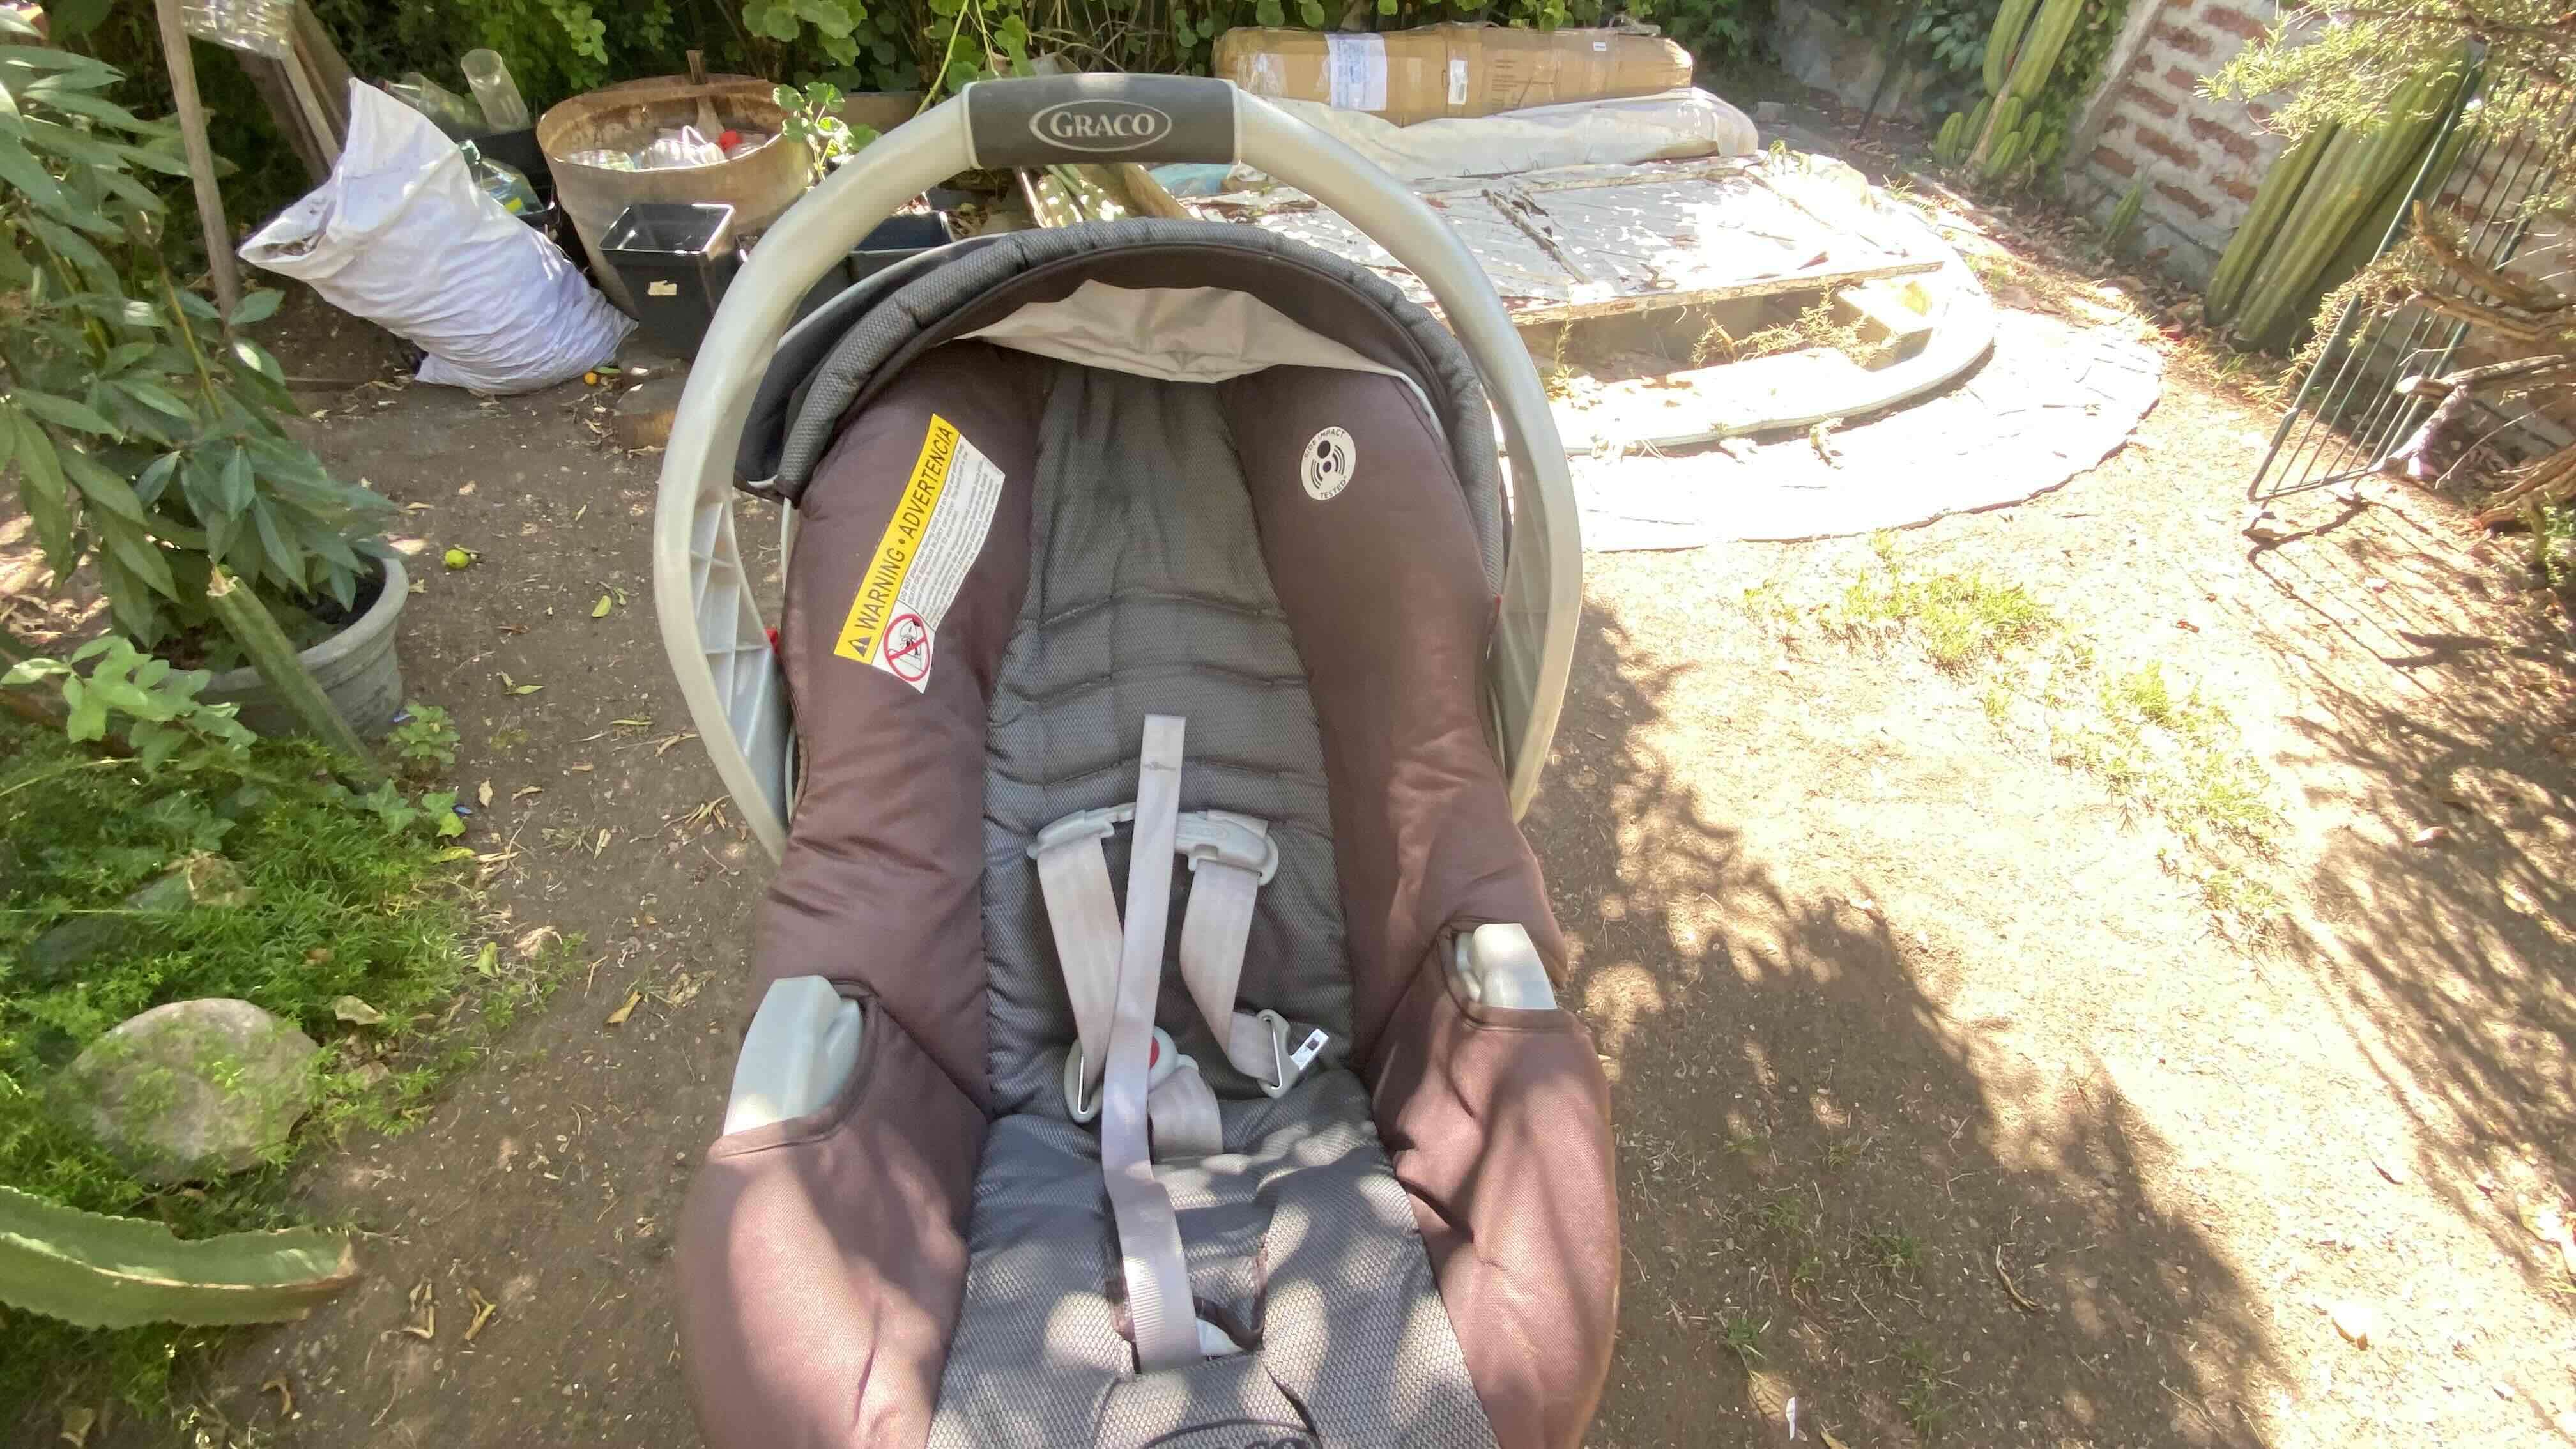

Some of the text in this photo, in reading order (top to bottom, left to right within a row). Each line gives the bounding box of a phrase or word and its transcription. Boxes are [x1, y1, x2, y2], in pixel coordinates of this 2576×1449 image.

[1050, 111, 1156, 139] GRACO
[1304, 429, 1346, 459] SIDE IMPACT
[1320, 480, 1346, 499] TESTED
[855, 548, 905, 631] WARNING
[899, 427, 953, 540] ADVERTENCIA
